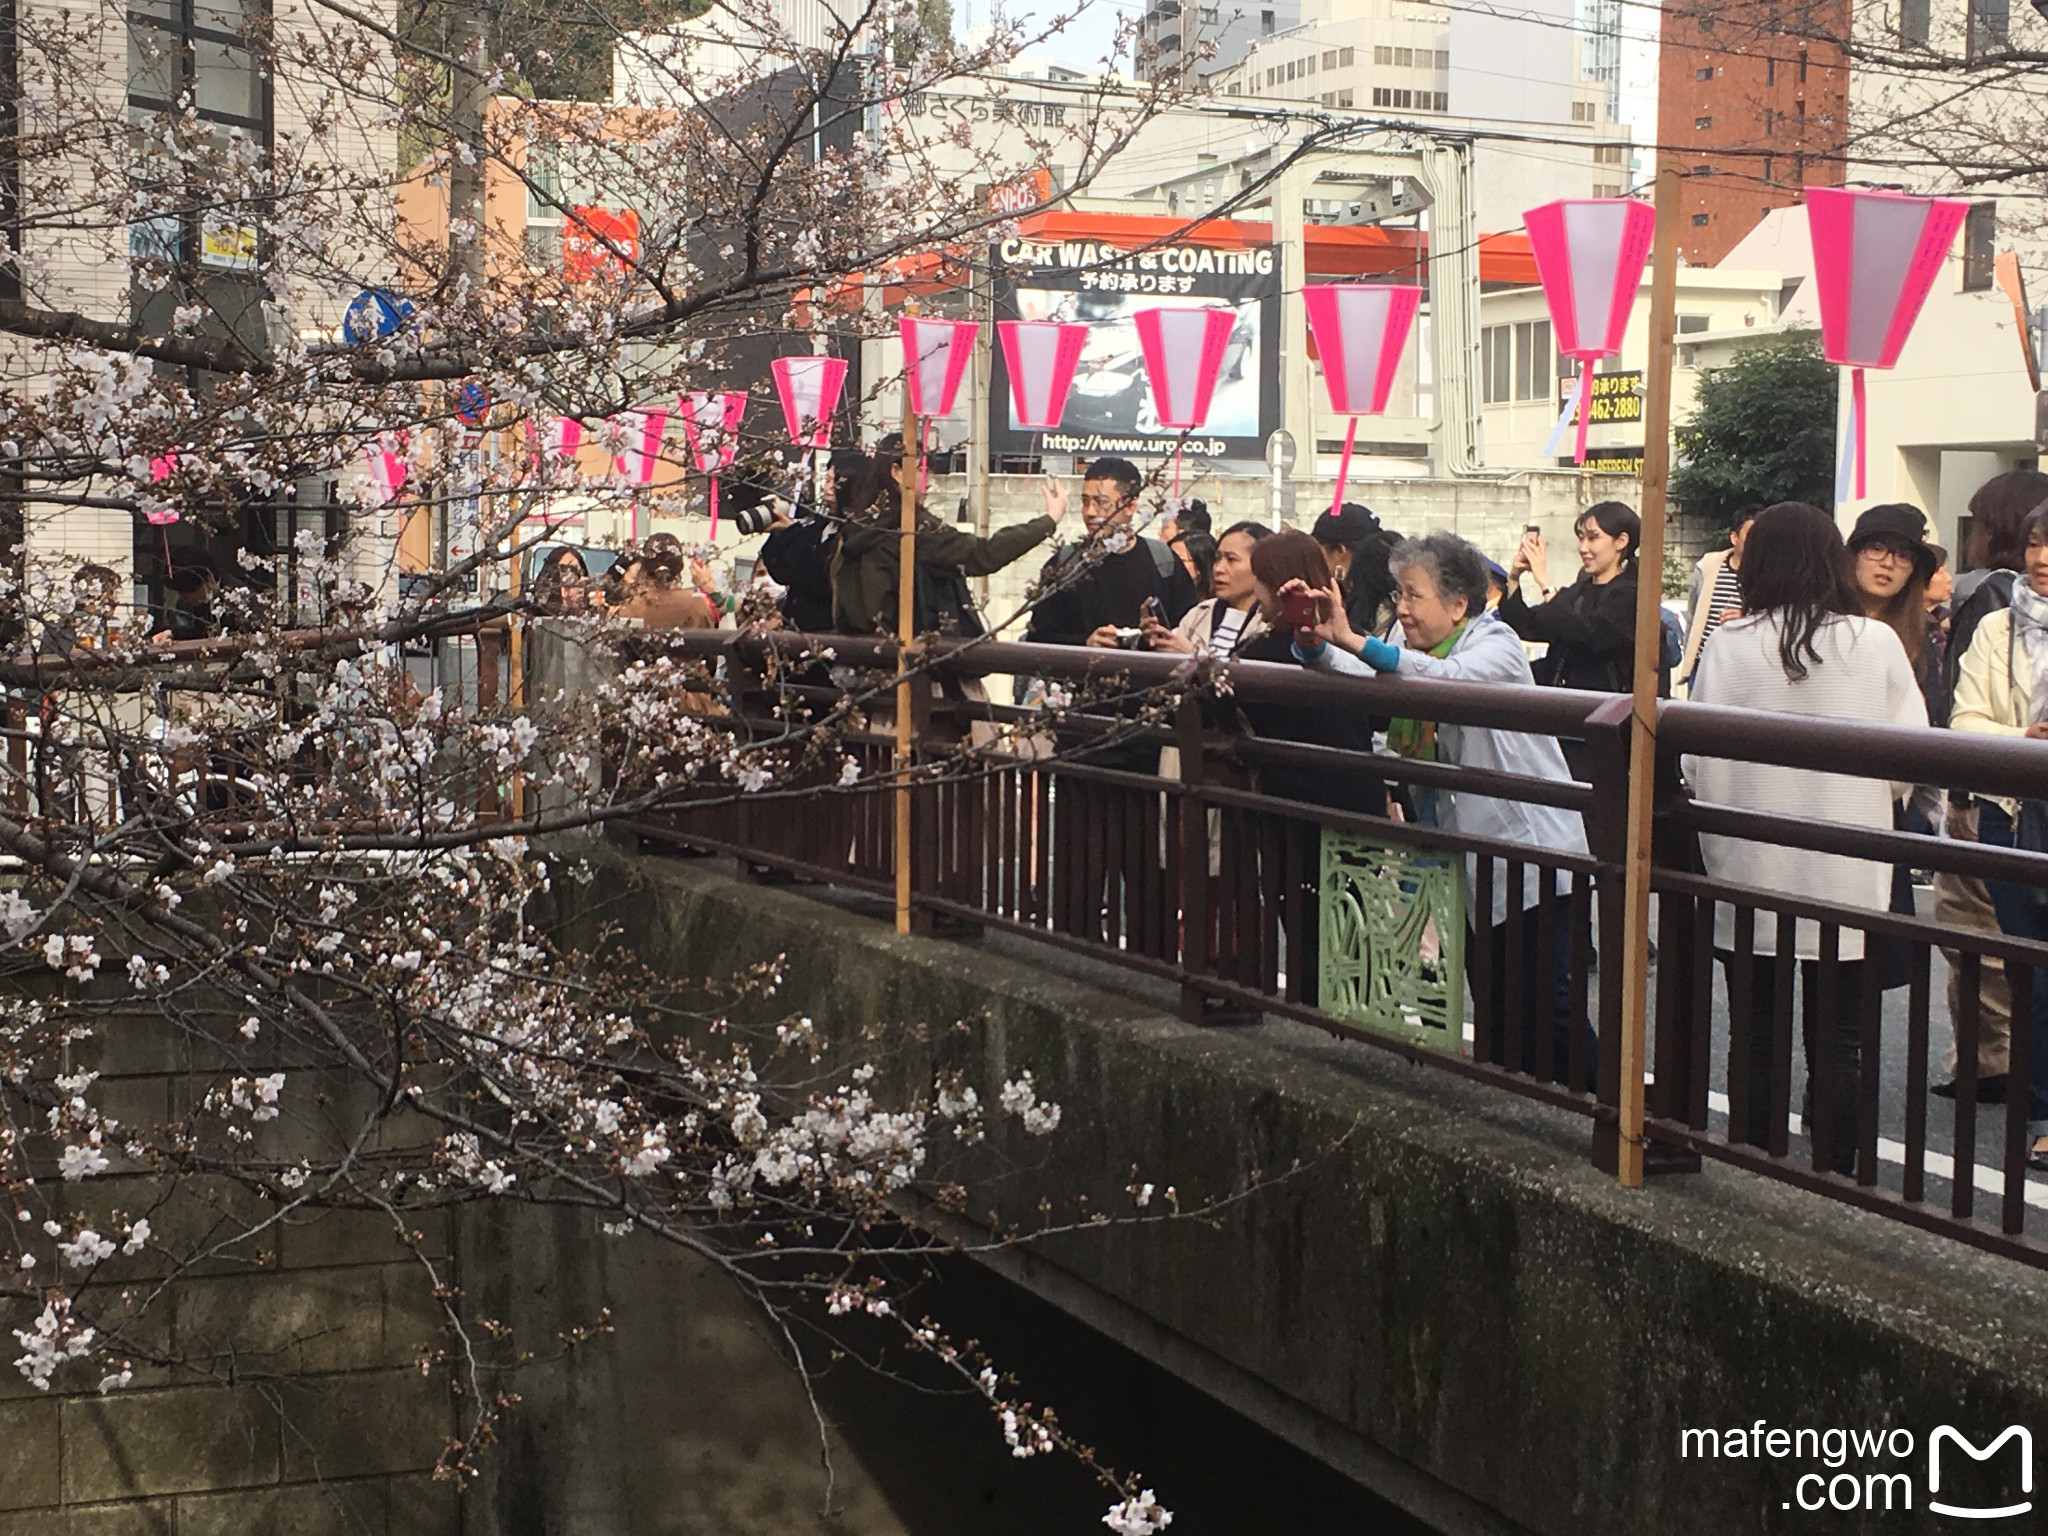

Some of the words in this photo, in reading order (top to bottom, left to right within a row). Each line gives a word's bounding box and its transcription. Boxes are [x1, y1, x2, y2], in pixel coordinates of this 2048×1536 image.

[904, 92, 1066, 128] 郷さくら美術館
[1000, 239, 1053, 266] CAR
[1138, 251, 1158, 270] &
[1162, 247, 1273, 275] COATING
[1079, 271, 1196, 293] 予約承ります
[1042, 434, 1227, 457] http://www.urg.co.jp
